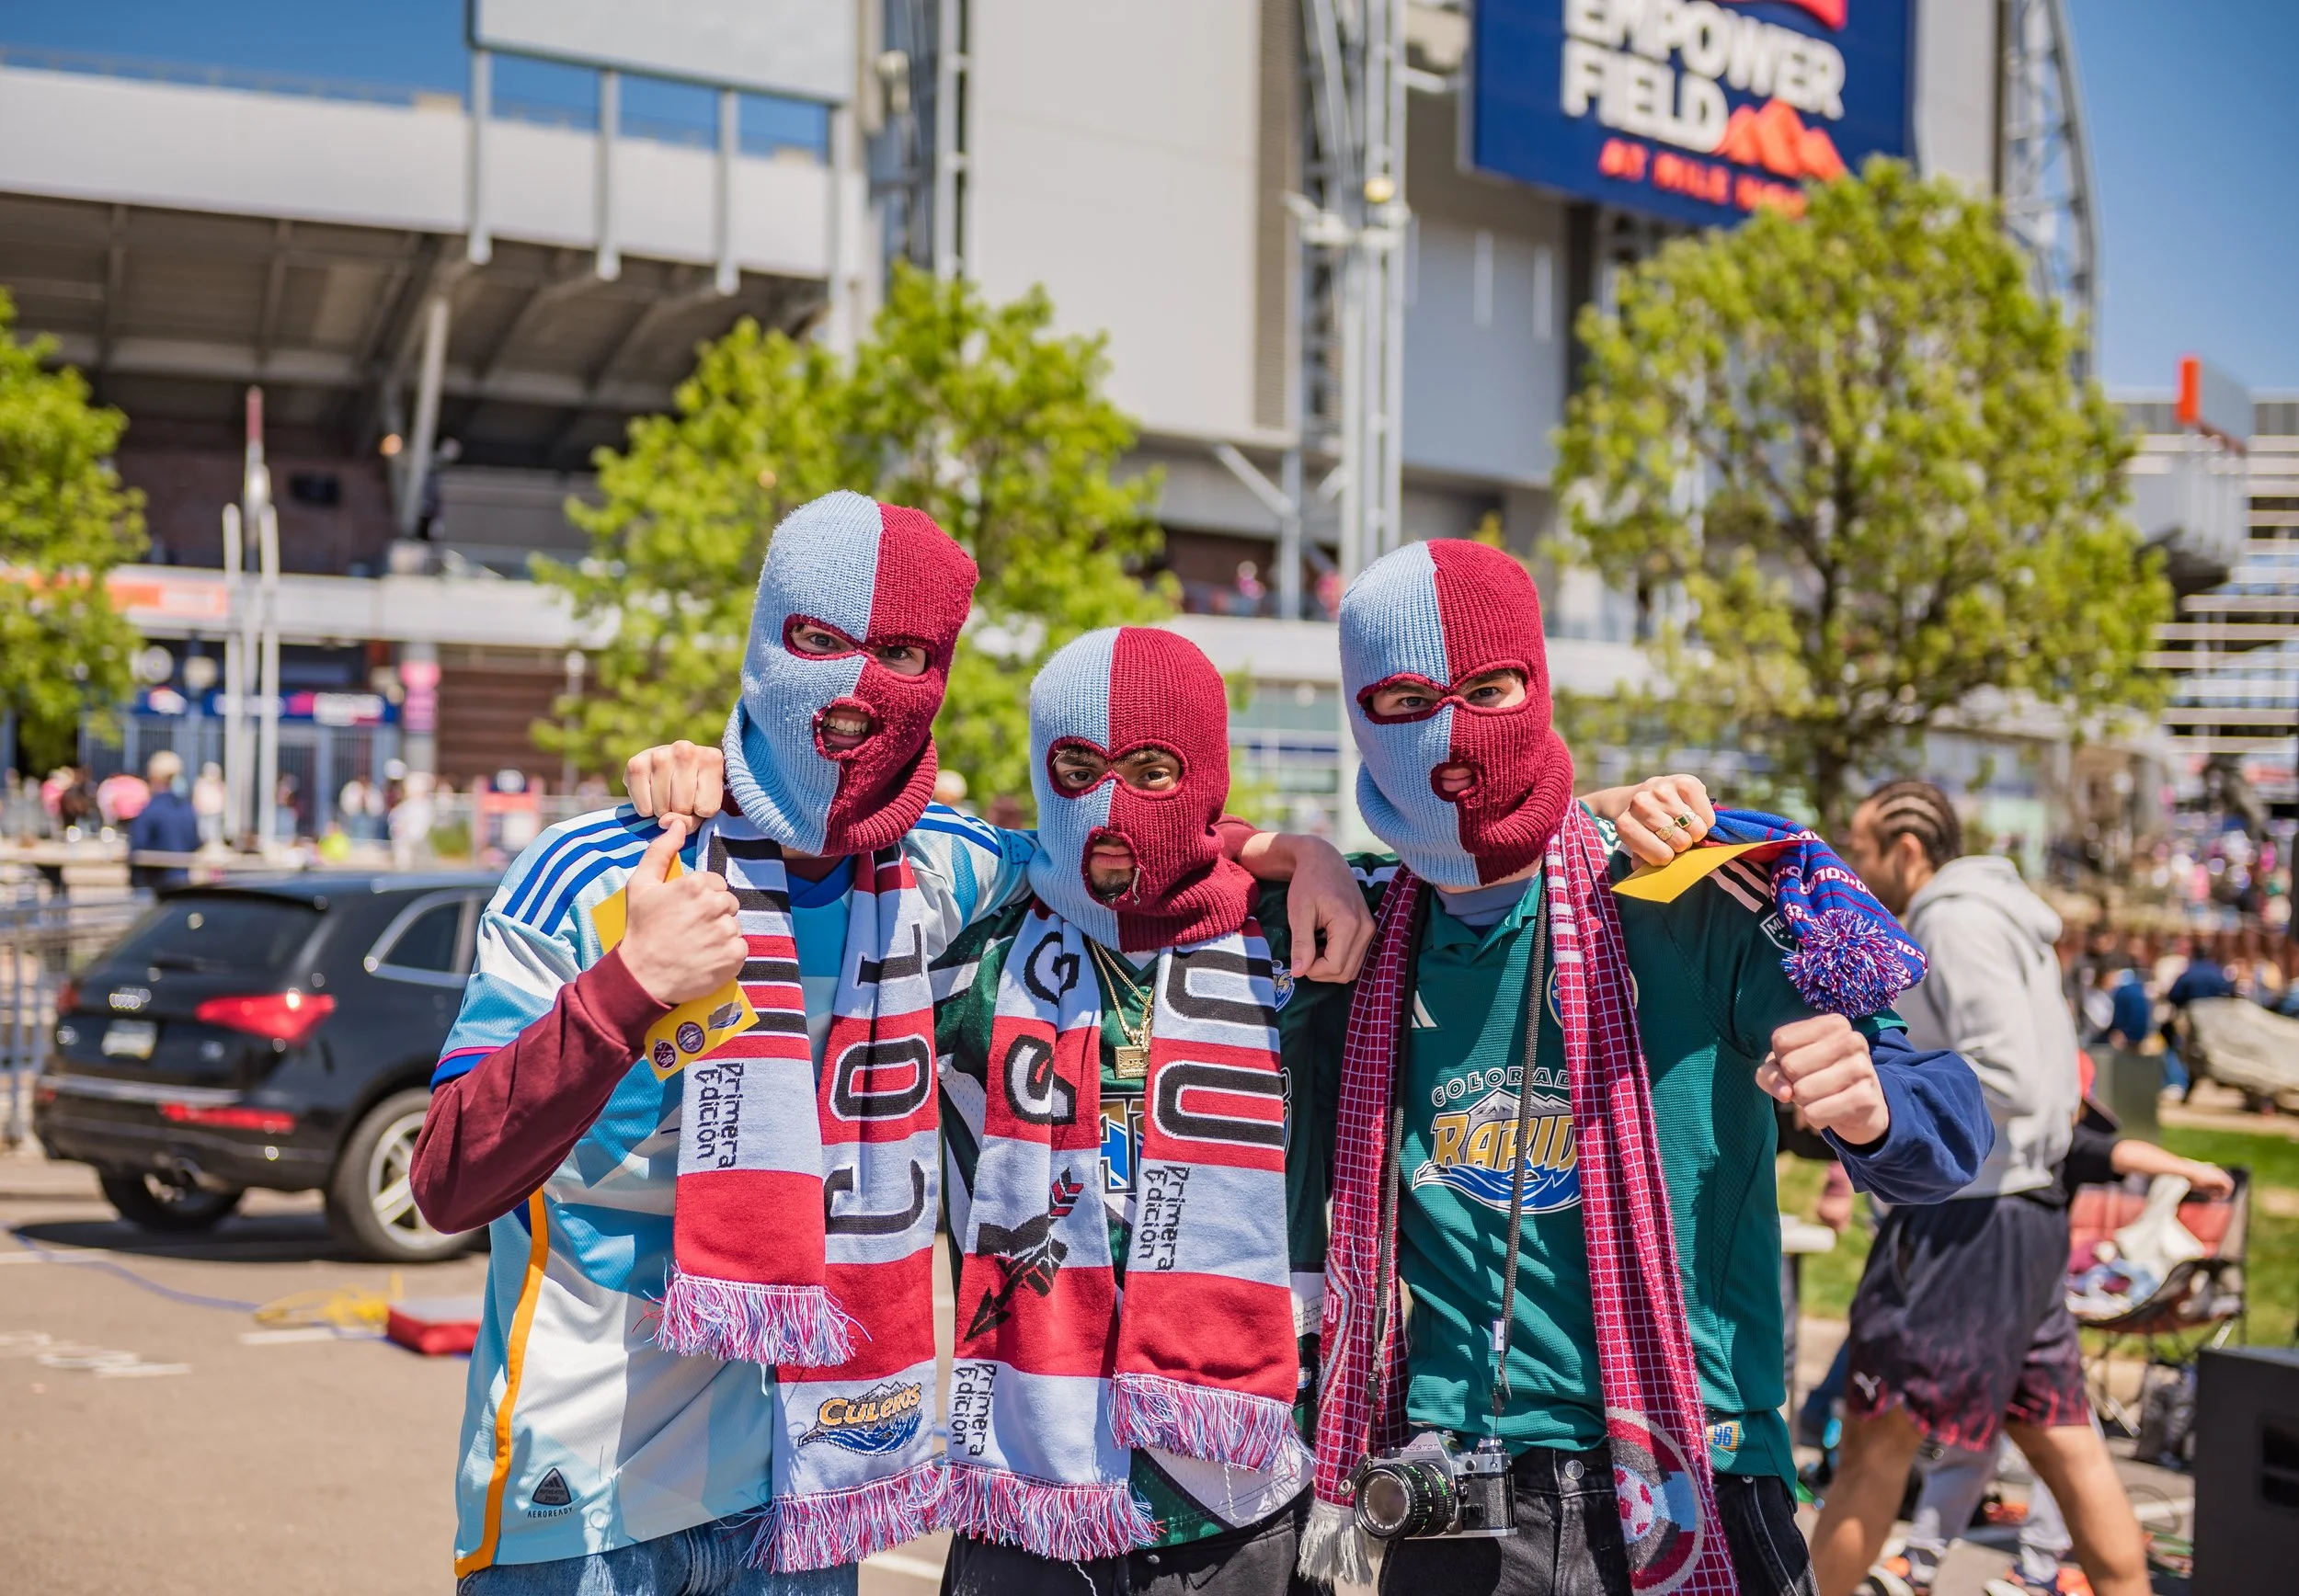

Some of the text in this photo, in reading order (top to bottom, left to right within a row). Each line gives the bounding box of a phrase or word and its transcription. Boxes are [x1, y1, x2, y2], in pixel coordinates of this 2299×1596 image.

[1561, 37, 1729, 154] FIELD
[1562, 0, 1846, 121] EMPOWER
[693, 1068, 719, 1160] Edición
[716, 1063, 744, 1169] Primera
[1432, 1066, 1572, 1107] COLORAD
[1430, 1112, 1578, 1172] RAPID
[1137, 1168, 1169, 1260] Edición
[1155, 1165, 1190, 1271] Primera
[951, 1365, 980, 1446] Edición
[967, 1362, 999, 1457] Primera
[1712, 1425, 1733, 1447] 96
[527, 1507, 573, 1519] AEROREADY
